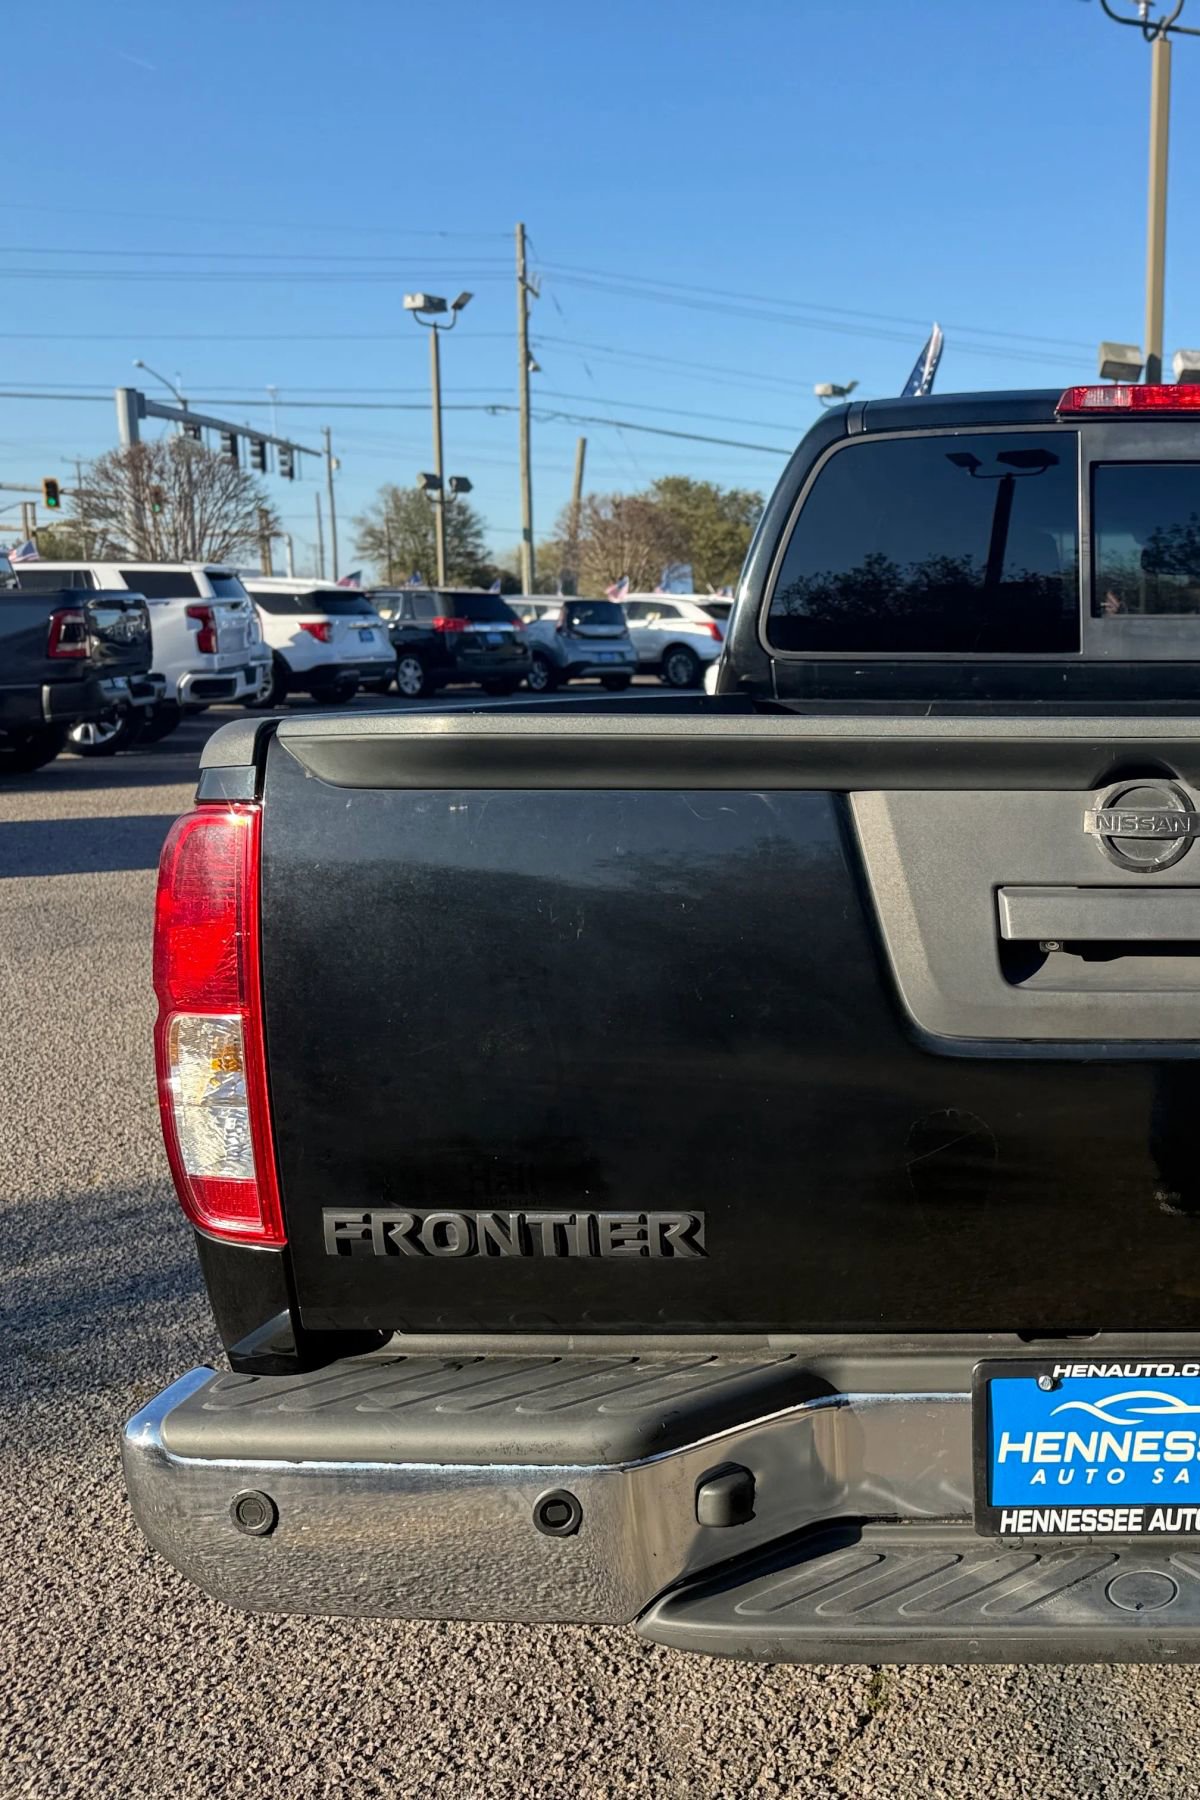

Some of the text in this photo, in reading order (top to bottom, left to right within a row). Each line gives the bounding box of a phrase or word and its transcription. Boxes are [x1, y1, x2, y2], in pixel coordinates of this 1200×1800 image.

[1095, 814, 1191, 833] NISSAN
[322, 1206, 709, 1258] FRONTIER
[1030, 1467, 1126, 1485] AUTO
[1000, 1508, 1143, 1533] HENNESSEE
